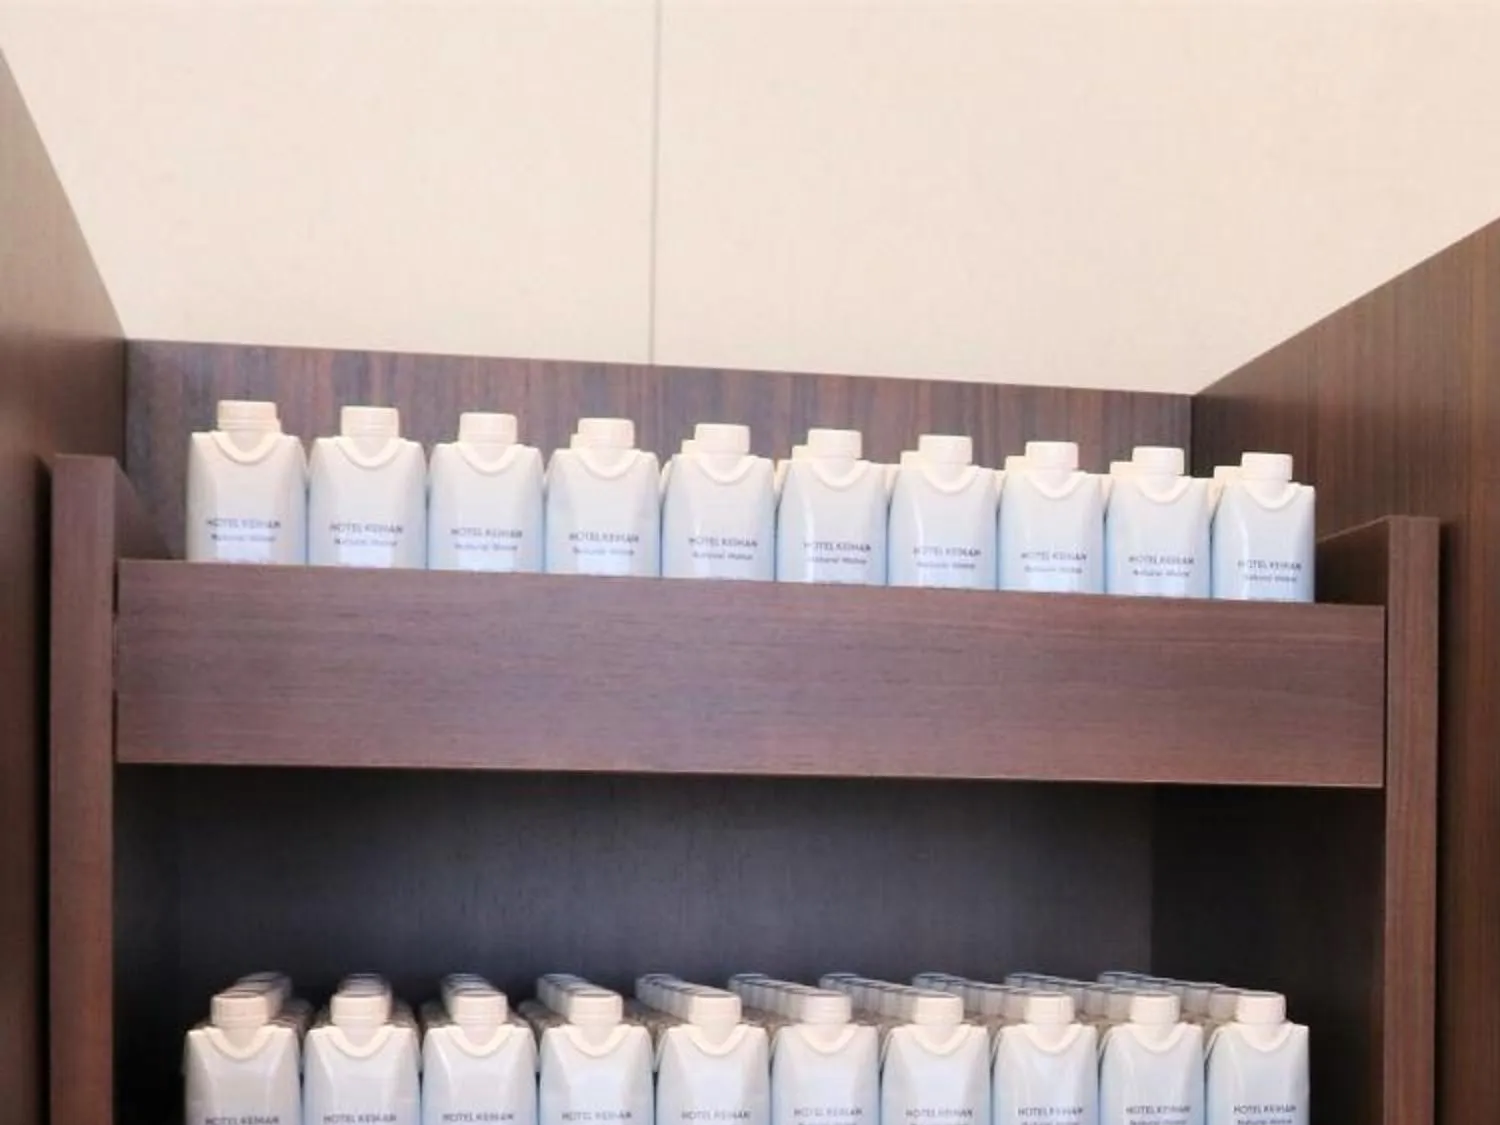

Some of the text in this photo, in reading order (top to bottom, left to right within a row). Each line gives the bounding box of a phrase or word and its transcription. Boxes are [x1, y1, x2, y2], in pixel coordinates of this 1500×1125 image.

[794, 1108, 825, 1117] HOTEL
[906, 1108, 937, 1118] HOTEL
[1018, 1107, 1048, 1117] HOTEL
[1125, 1105, 1155, 1114] HOTEL
[1233, 1105, 1262, 1114] HOTEL
[323, 1113, 357, 1124] HOTEL
[442, 1113, 476, 1123] HOTEL
[561, 1112, 594, 1121] HOTEL
[681, 1111, 714, 1121] HOTEL
